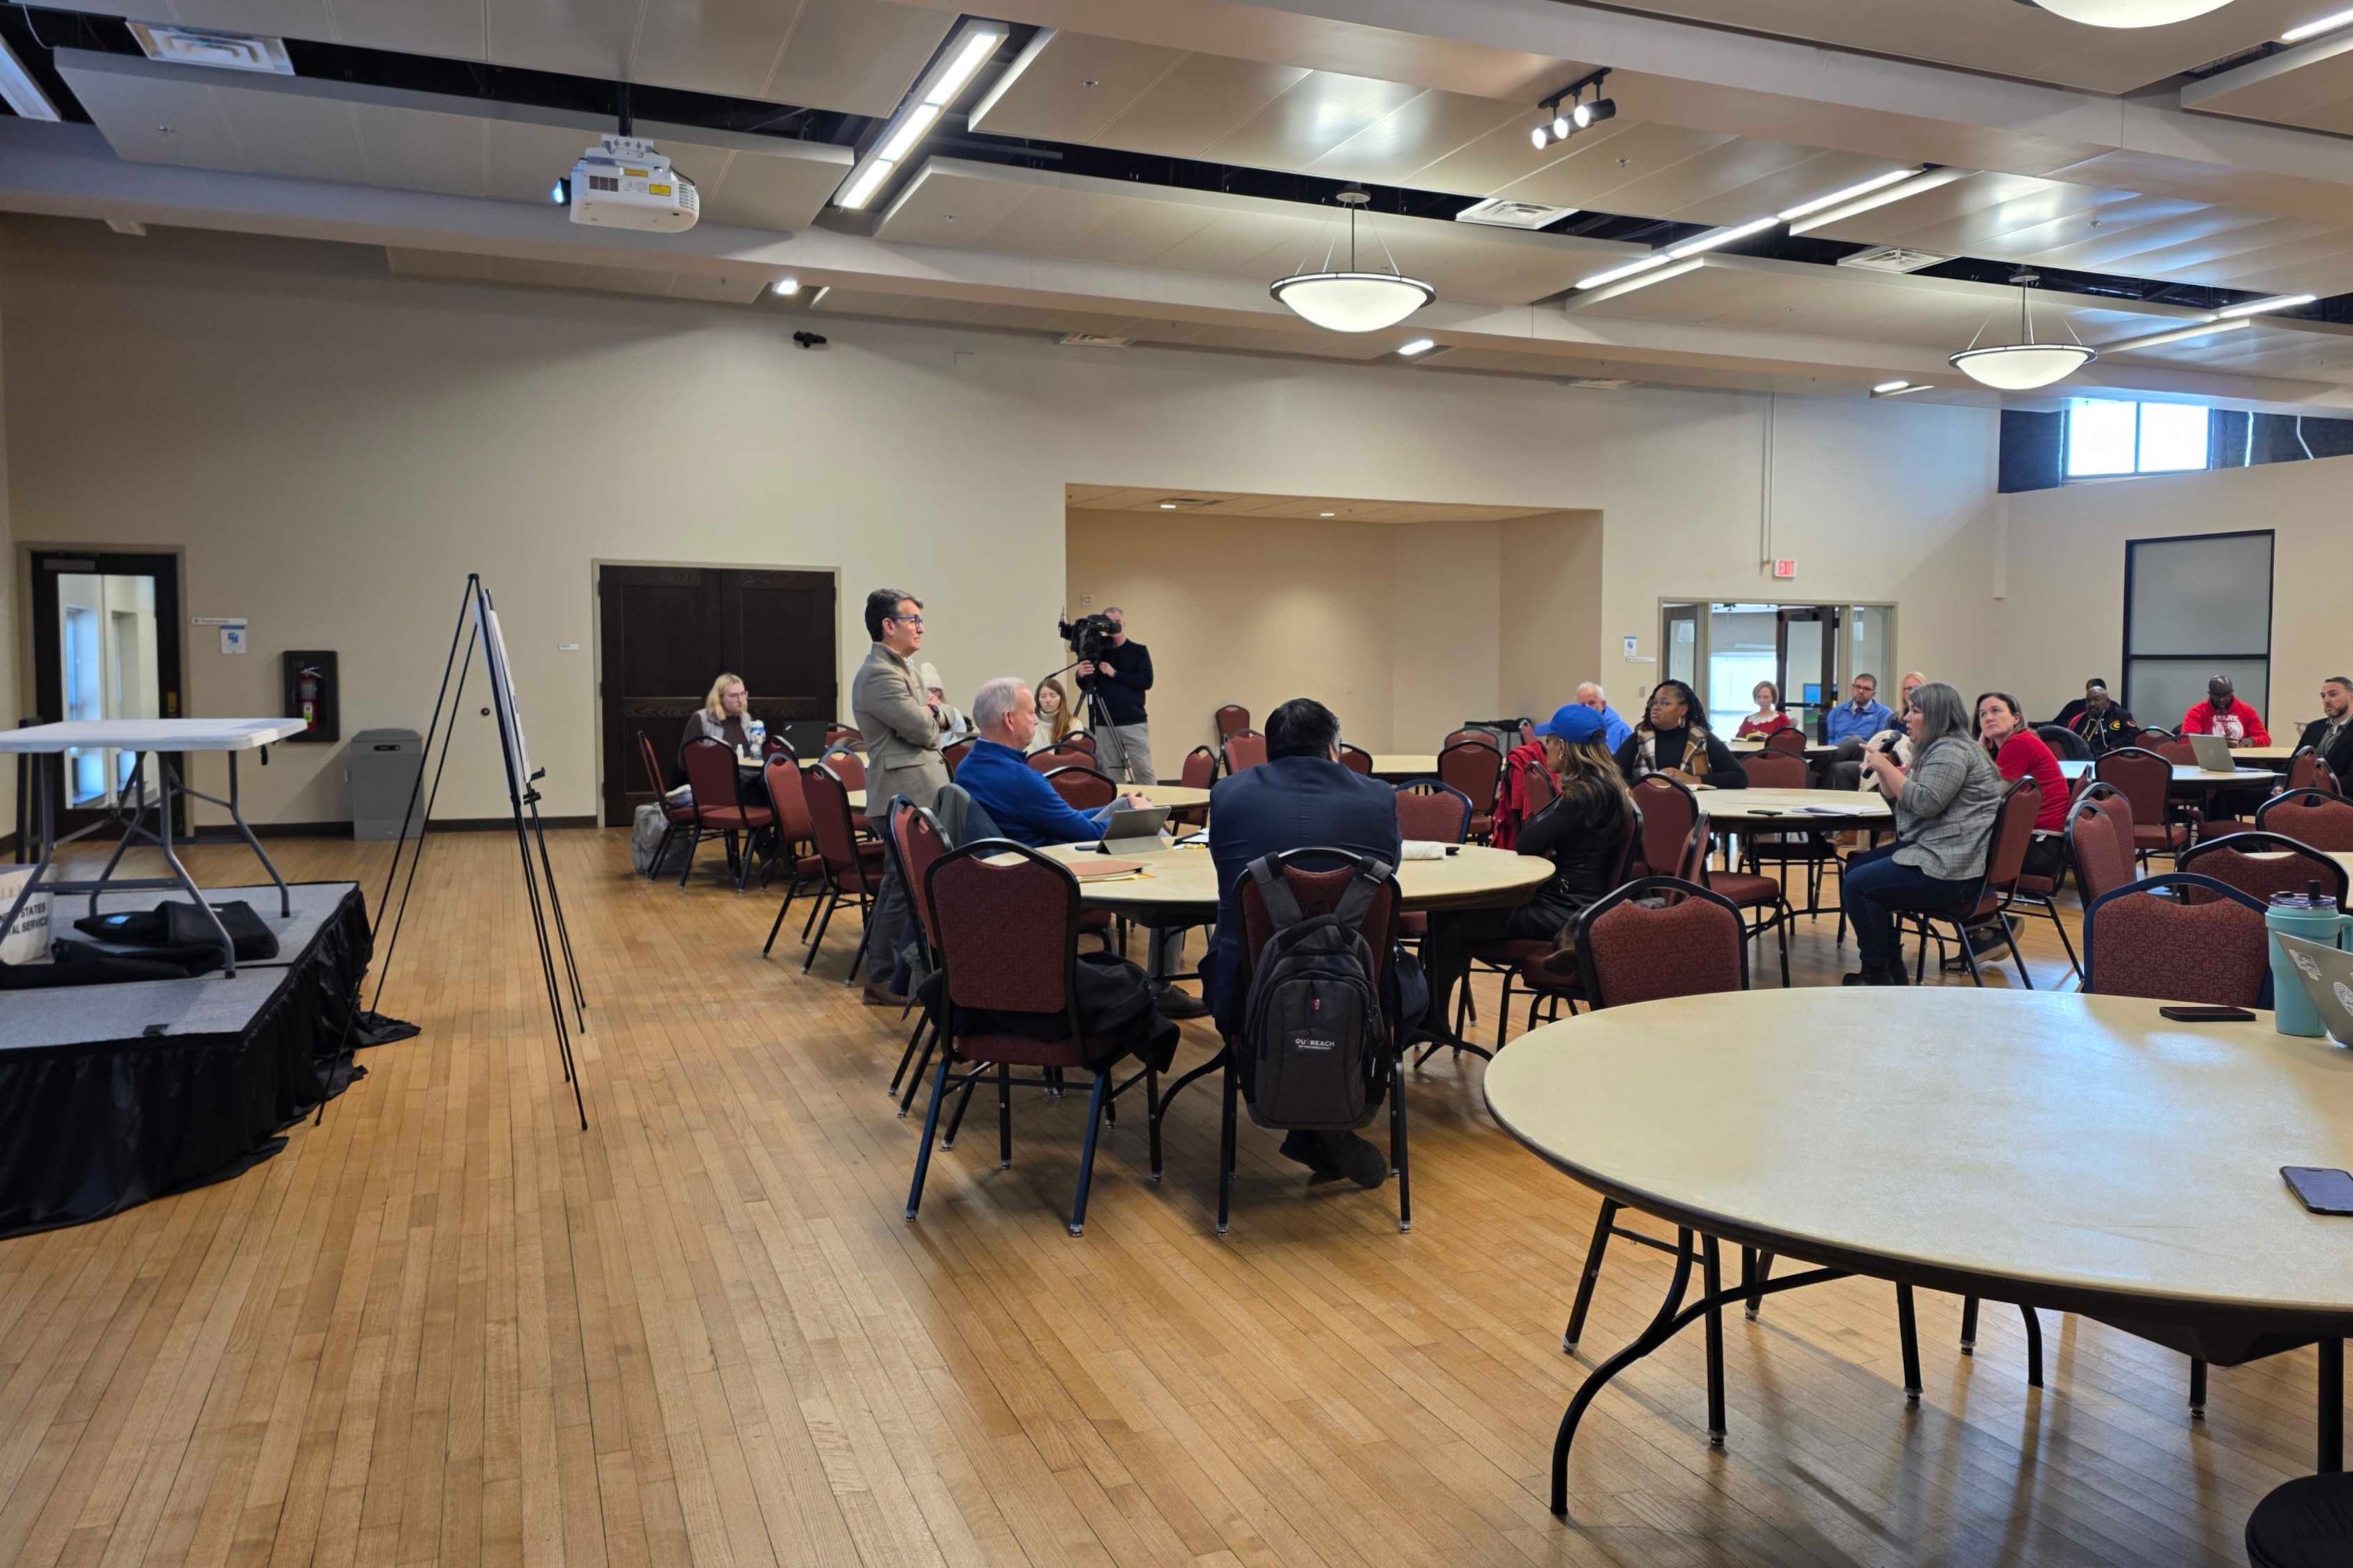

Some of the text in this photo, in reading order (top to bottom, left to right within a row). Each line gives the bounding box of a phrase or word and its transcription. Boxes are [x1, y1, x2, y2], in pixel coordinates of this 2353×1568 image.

[1779, 561, 1795, 575] EXIT
[21, 902, 46, 918] STATES
[22, 916, 49, 933] SERVICE
